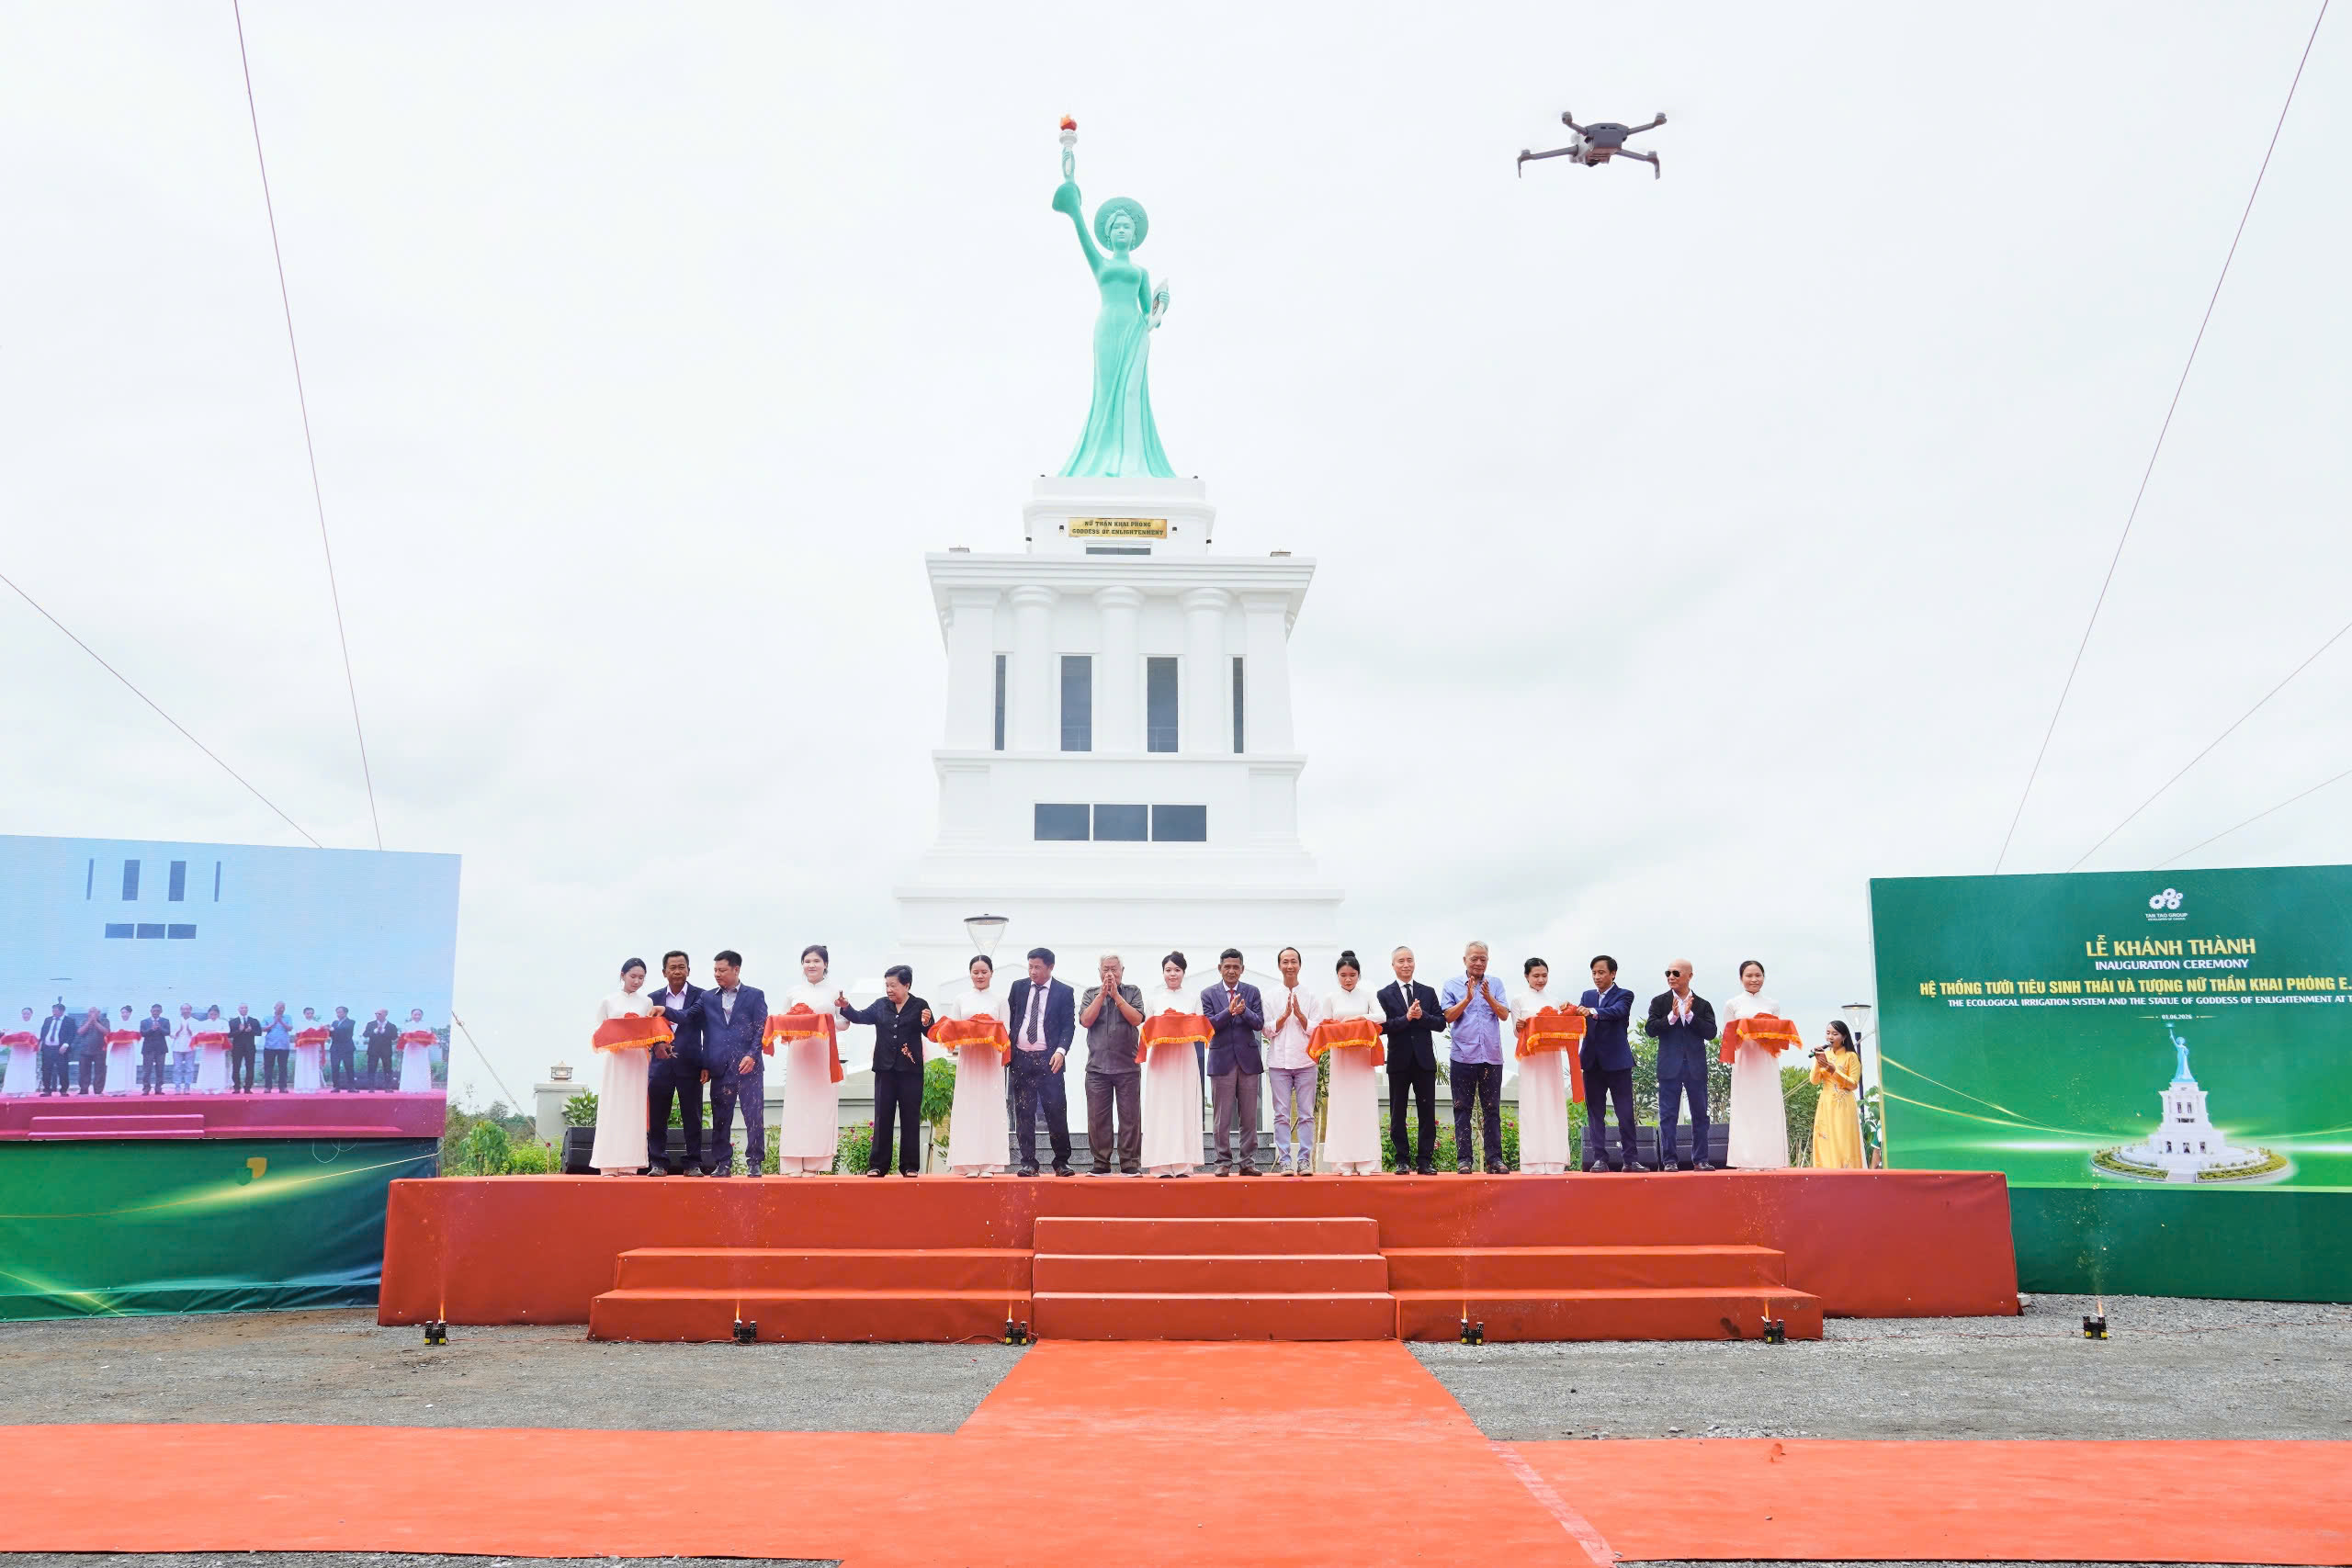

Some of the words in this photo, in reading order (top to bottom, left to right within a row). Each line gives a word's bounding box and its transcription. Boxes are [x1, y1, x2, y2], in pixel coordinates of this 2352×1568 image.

[2086, 934, 2109, 956] LỄ
[2113, 936, 2183, 956] KHÁNH
[2188, 935, 2256, 955] THÀNH
[2095, 960, 2180, 971] INAUGURATION
[2183, 959, 2249, 969] CEREMONY
[1919, 980, 1937, 998] HỆ
[1939, 978, 1983, 995] THỐNG
[2017, 979, 2046, 994] TIÊU
[2049, 980, 2081, 994] SINH
[2084, 977, 2114, 993] THÁI
[2117, 977, 2136, 993] VÀ
[2138, 978, 2184, 995] TƯỢNG
[2187, 976, 2207, 993] NỮ
[2210, 975, 2246, 992] THẦN
[2249, 977, 2283, 991] KHAI
[2286, 975, 2336, 991] PHÓNG
[1966, 998, 2019, 1007] ECOLOGICAL
[2021, 998, 2070, 1006] IRRIGATION
[2129, 997, 2146, 1005] THE
[2148, 997, 2179, 1005] STATUE
[2256, 995, 2332, 1004] ENLIGHTENMENT
[2335, 995, 2346, 1003] AT
